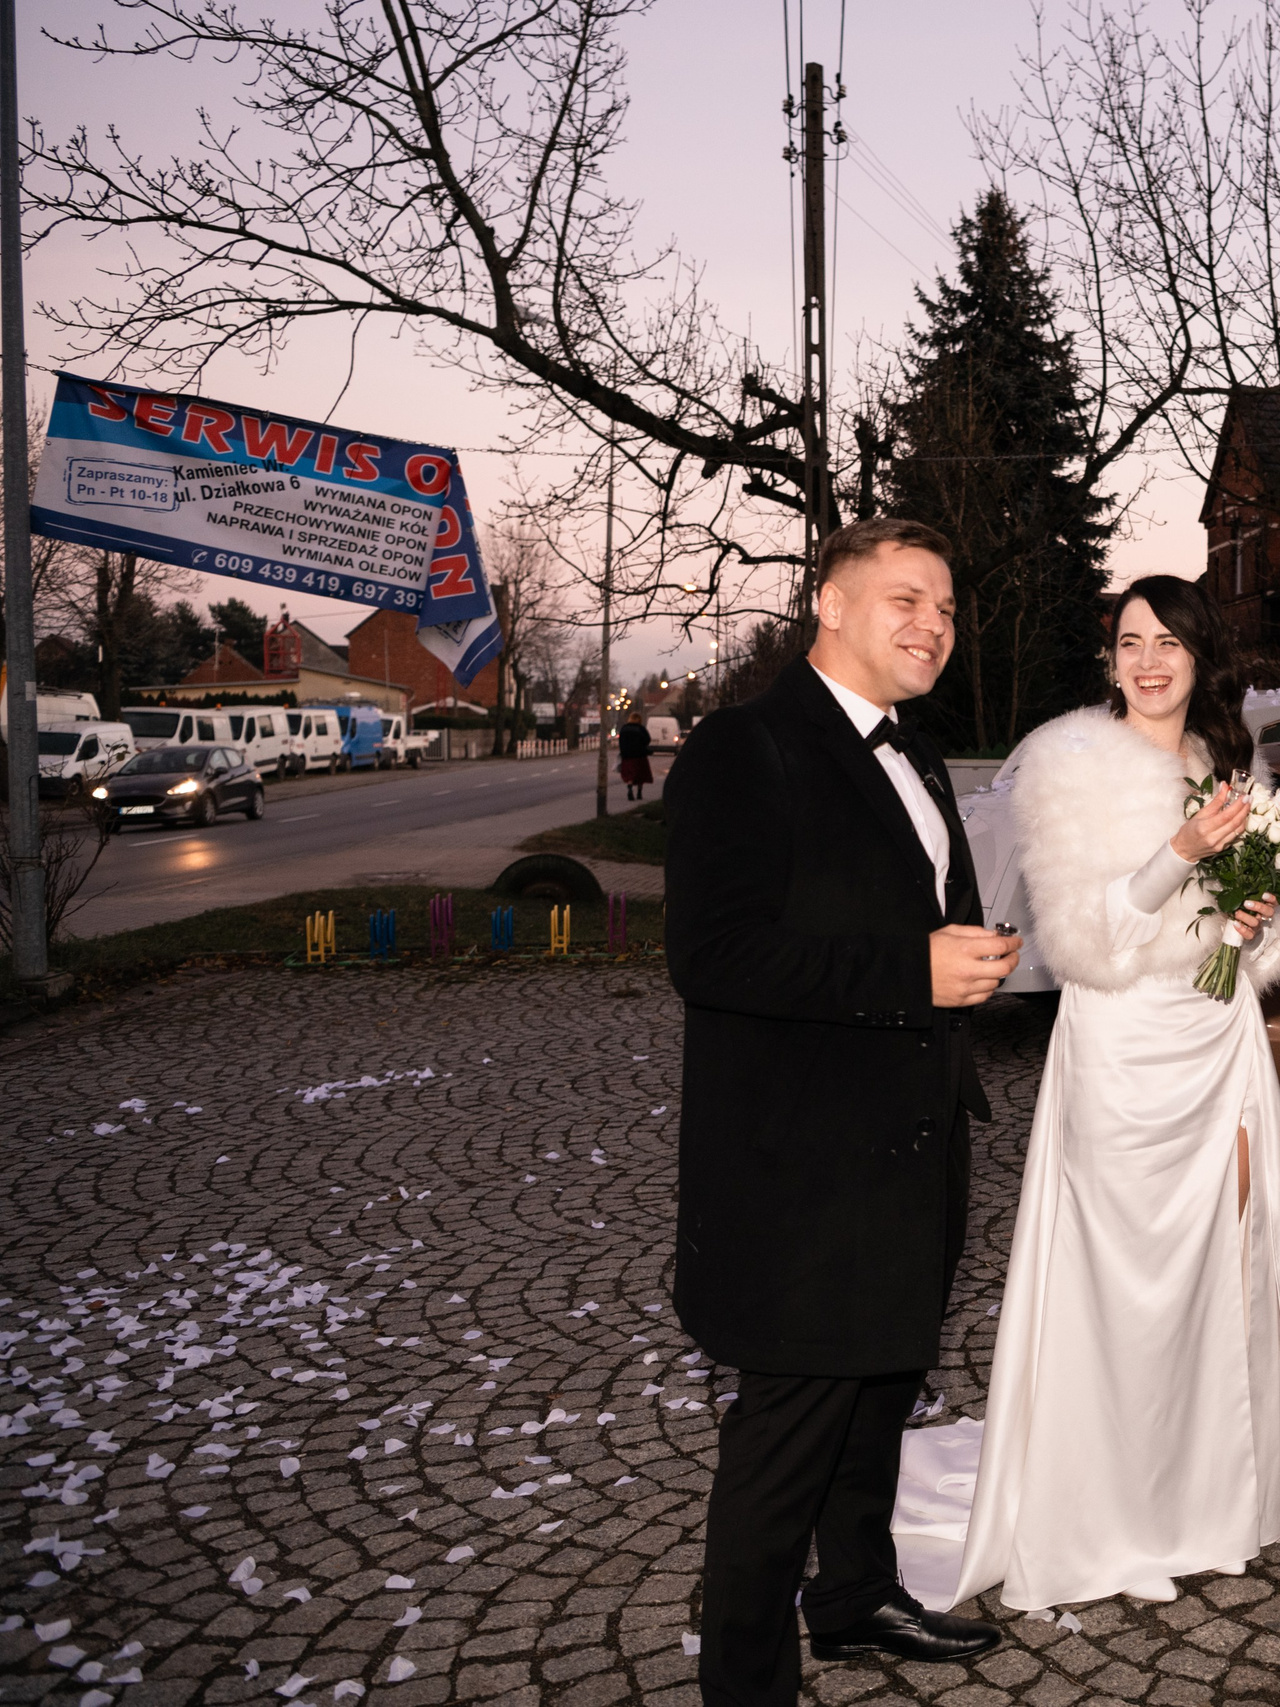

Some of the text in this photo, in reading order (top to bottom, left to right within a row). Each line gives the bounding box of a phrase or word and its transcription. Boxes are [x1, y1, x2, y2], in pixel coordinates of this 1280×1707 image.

[88, 384, 382, 482] SERWIS
[77, 466, 169, 488] Zapraszamy:
[173, 459, 291, 482] Kamieniec Wr.
[174, 475, 300, 503] ul. Działkowa 6
[77, 484, 96, 497] Pn
[110, 486, 124, 499] Pt
[130, 488, 169, 503] 10-18
[314, 485, 433, 522] WYMIANA OPON
[232, 501, 428, 553] PRZECHOWYWANIE OPON
[303, 499, 430, 538] WYWAŻANIE KÓŁ
[206, 511, 425, 568] NAPRAWA I SPRZEDAŻ OPON
[214, 552, 254, 574] 609
[258, 562, 298, 584] 439
[302, 571, 346, 597] 419,
[351, 581, 390, 602] 697
[281, 543, 423, 583] WYMIANA OLEJÓW
